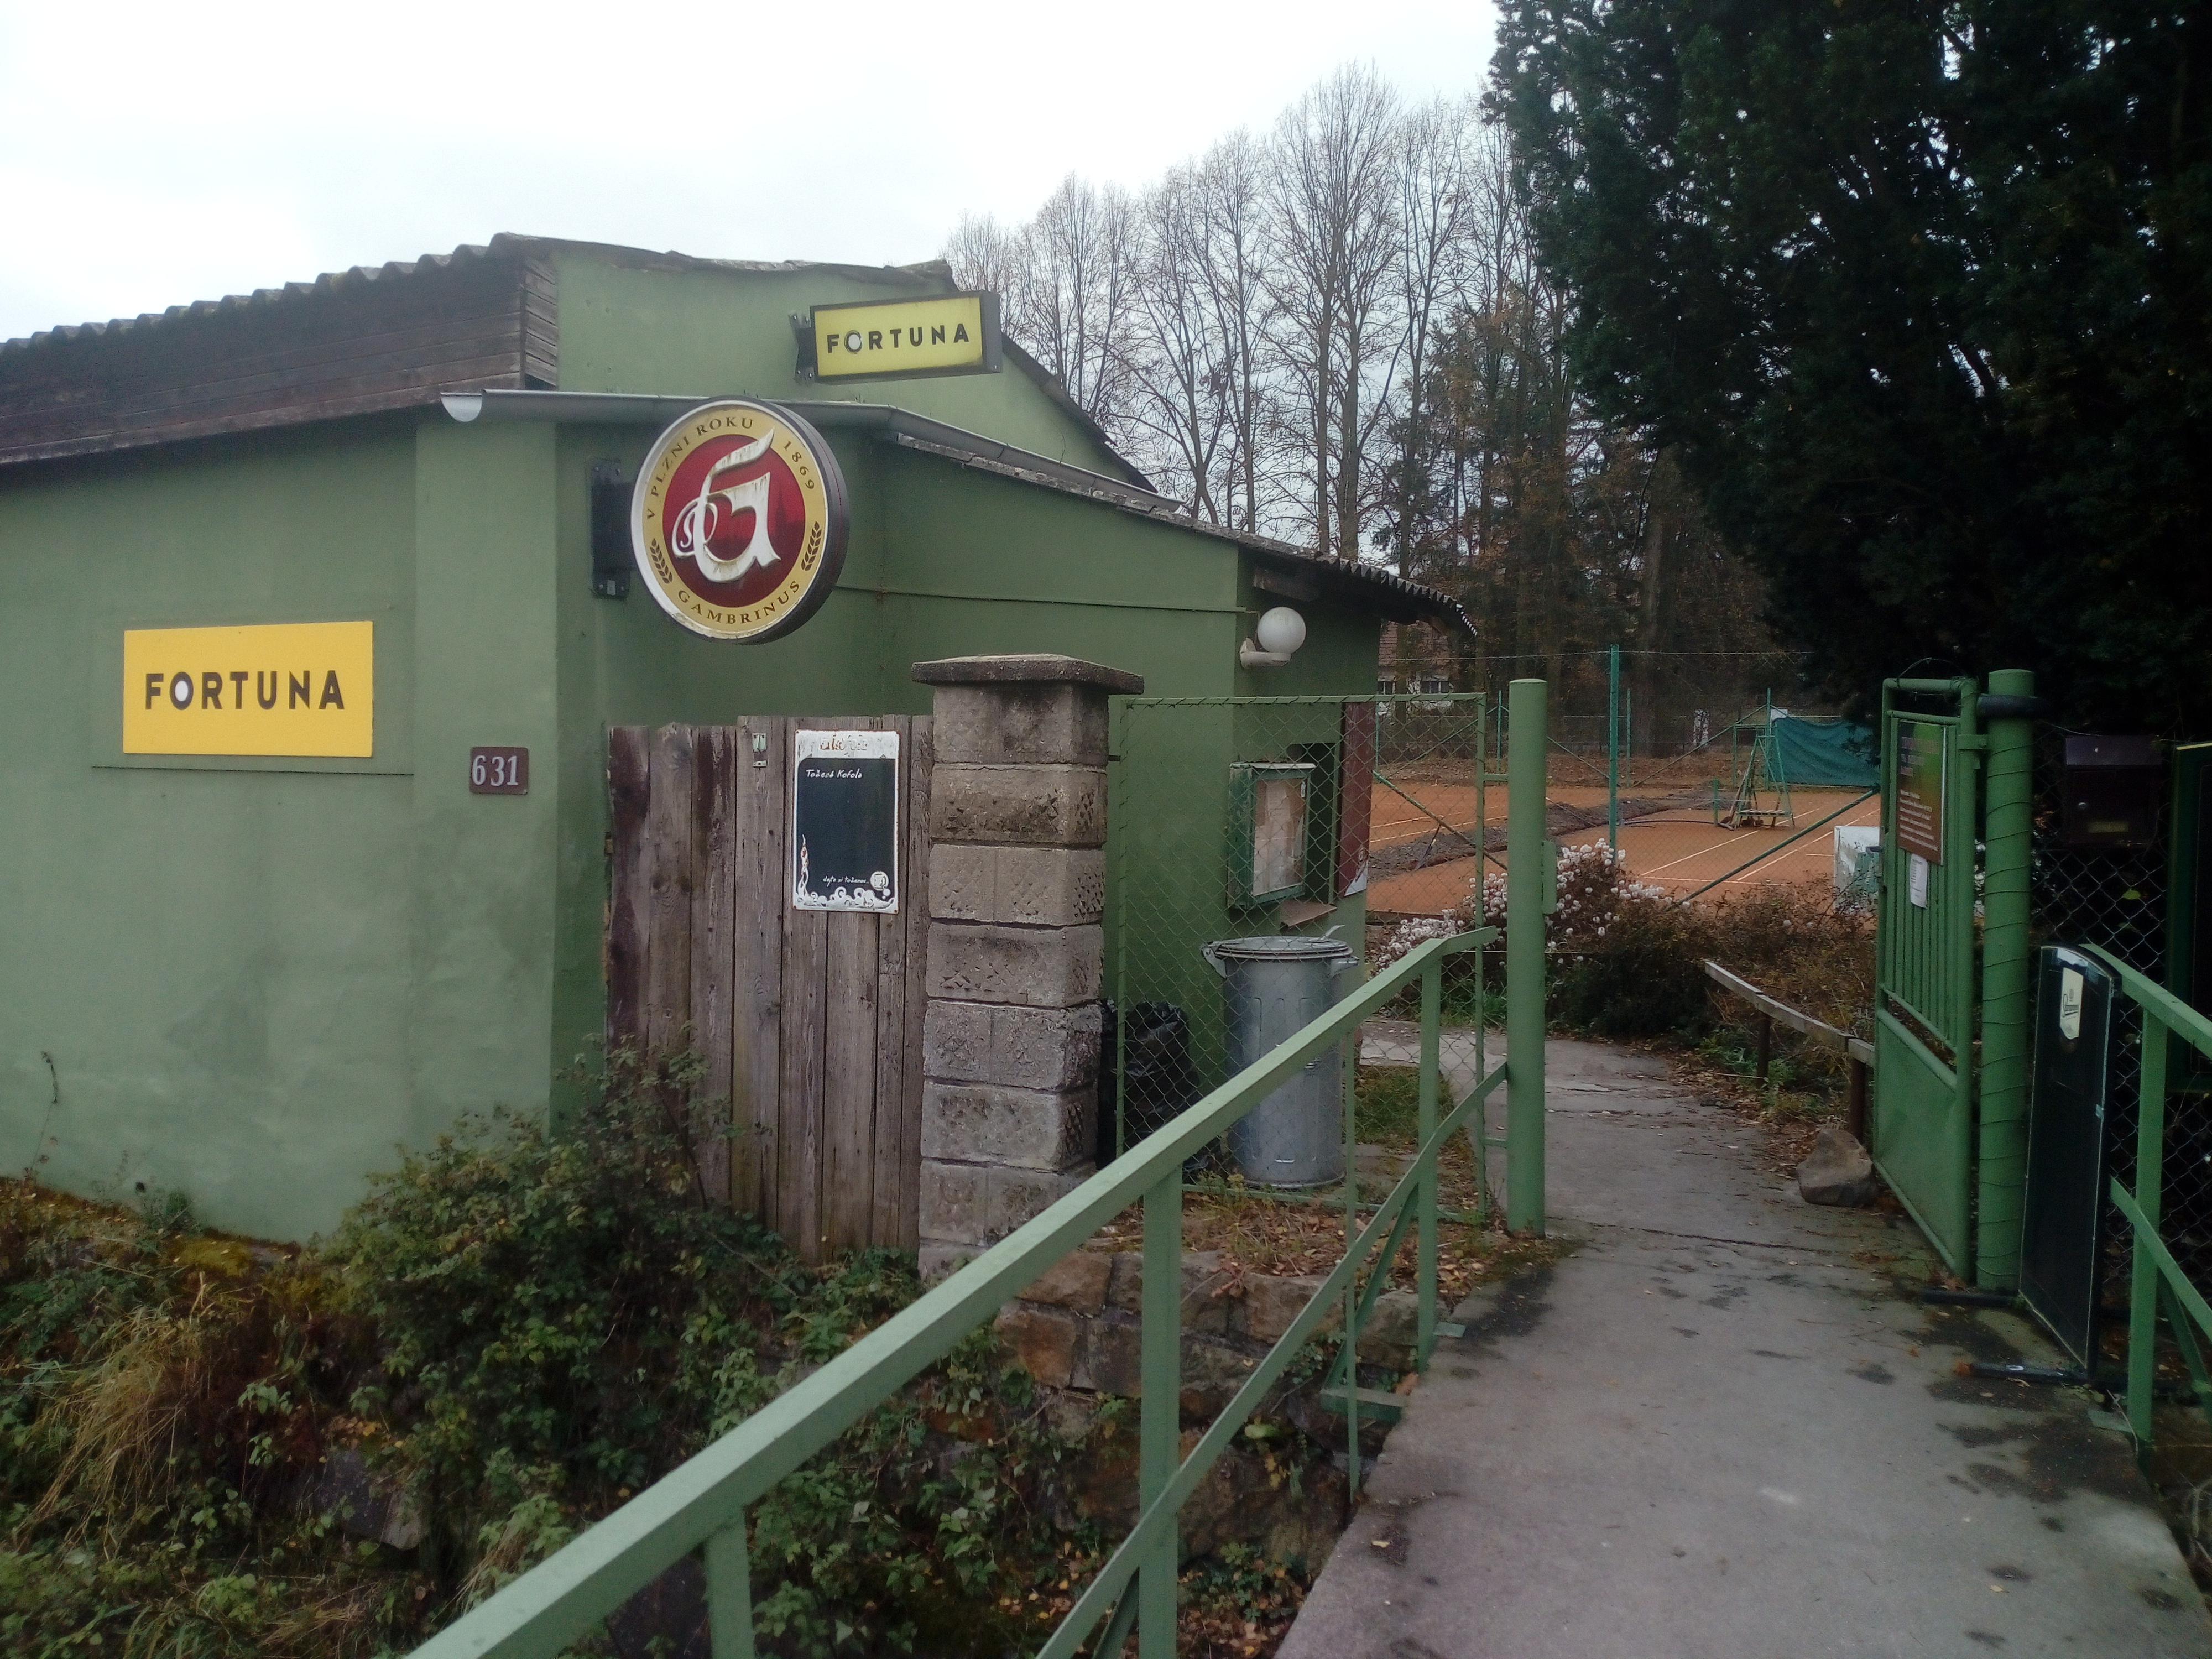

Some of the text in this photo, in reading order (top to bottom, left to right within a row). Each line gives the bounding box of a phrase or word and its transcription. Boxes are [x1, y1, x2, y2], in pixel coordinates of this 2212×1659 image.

[827, 323, 969, 354] FORTUNA
[696, 416, 754, 436] ROKU
[784, 441, 815, 490] 1869
[678, 580, 800, 625] GAMBRINUS
[145, 670, 345, 711] FORTUNA
[472, 755, 518, 786] 631
[837, 768, 863, 779] Kofola
